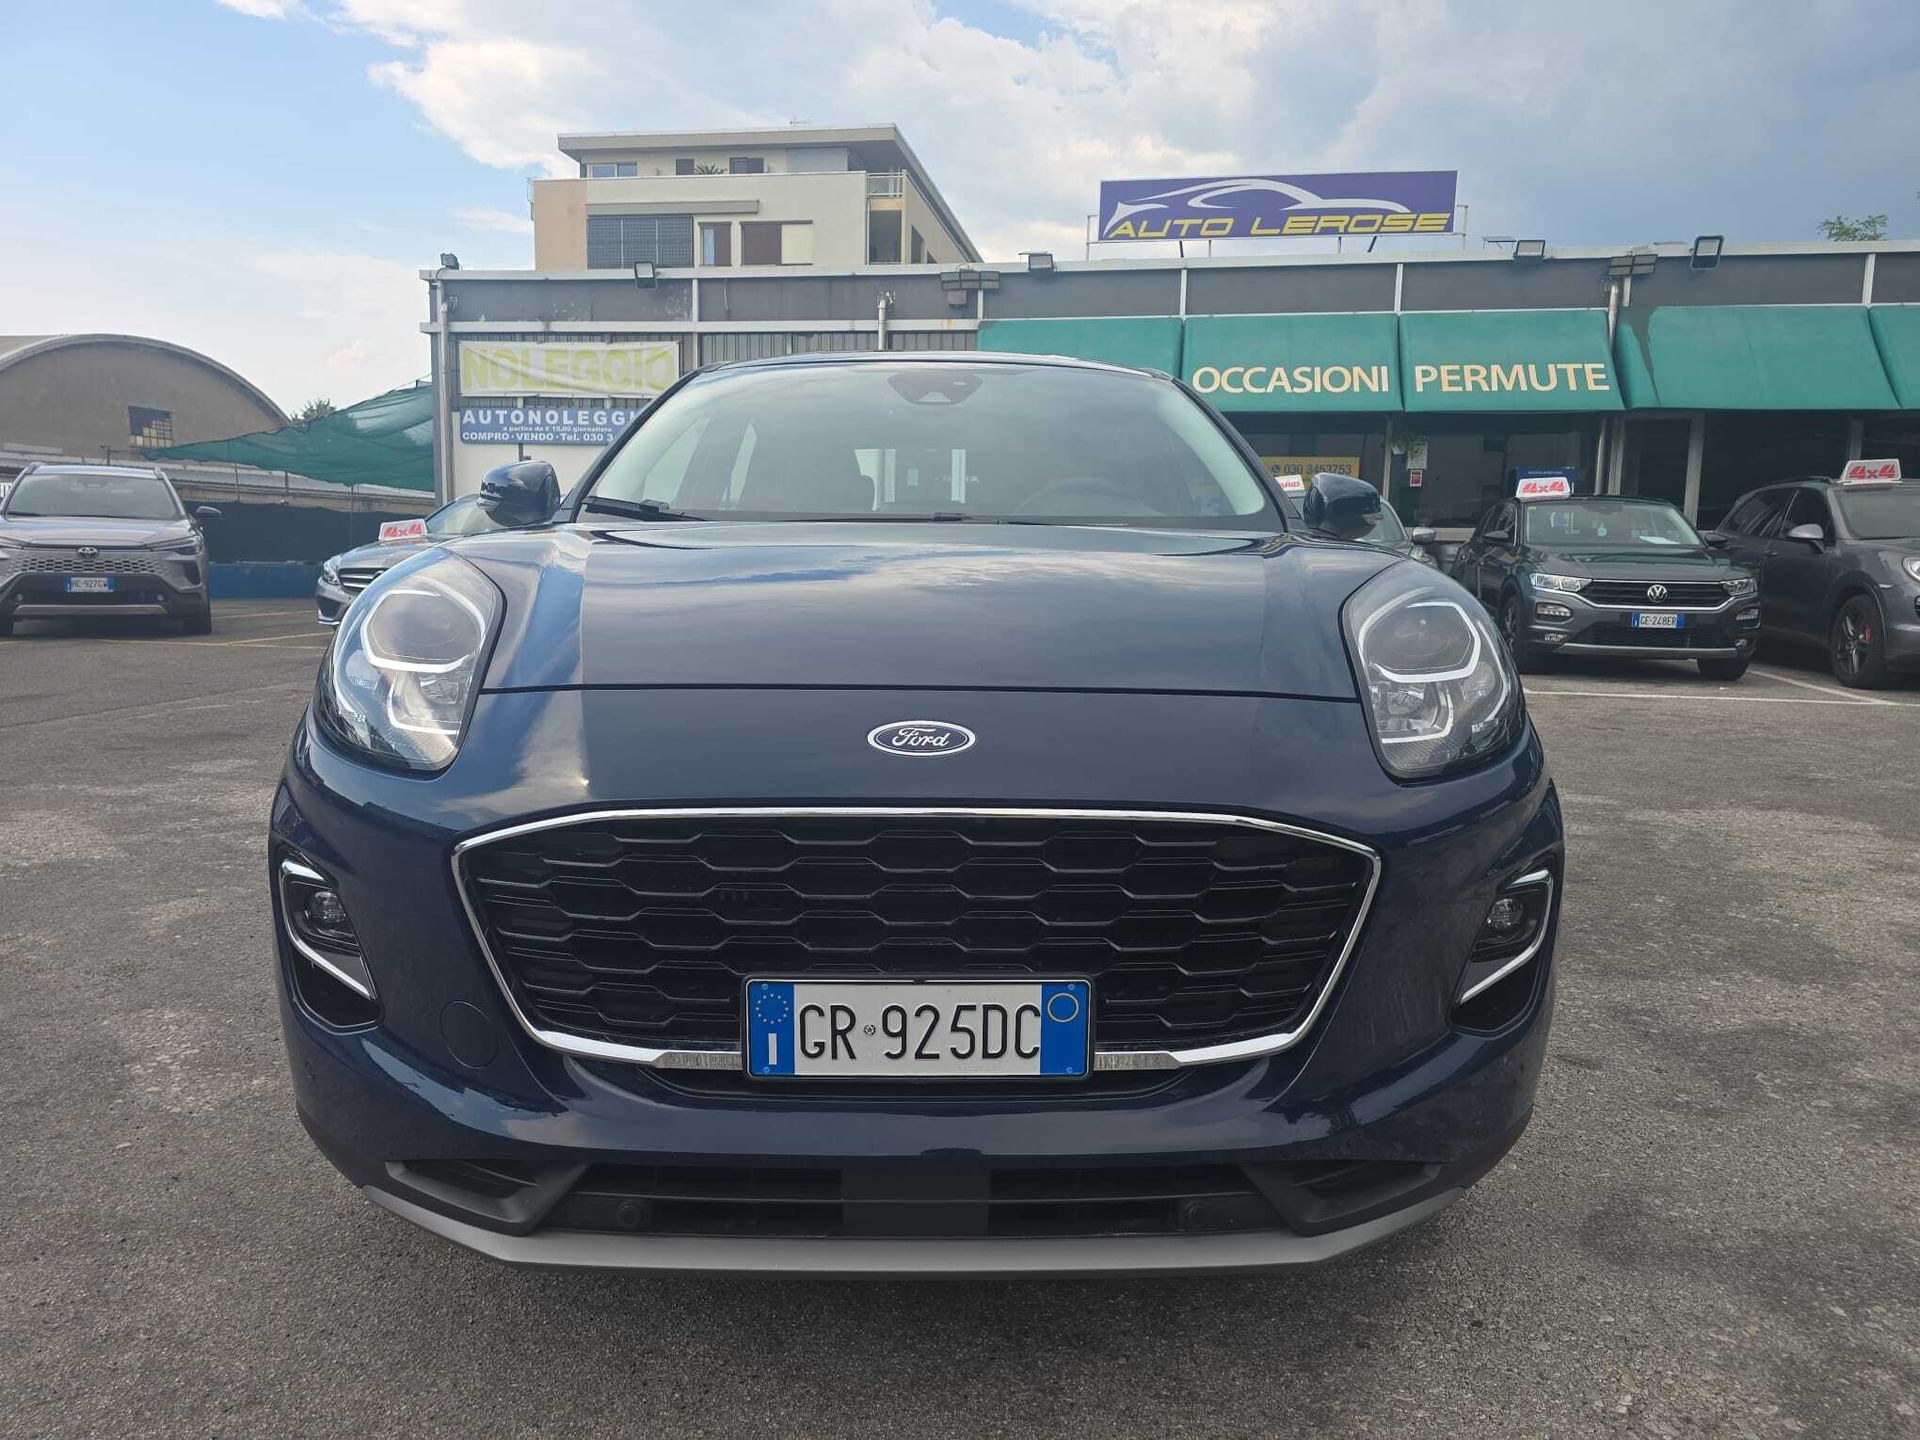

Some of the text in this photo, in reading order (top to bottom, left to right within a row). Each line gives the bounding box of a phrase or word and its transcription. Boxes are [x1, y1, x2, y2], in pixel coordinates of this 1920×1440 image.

[1107, 212, 1451, 238] AUTO LEROSE
[463, 347, 676, 391] NOLEGGIO
[1192, 363, 1610, 394] OCCASIONI PERMUTE
[462, 432, 510, 441] COMPRO
[516, 432, 554, 441] VENDO
[560, 432, 580, 441] Tel.
[583, 432, 604, 441] 030
[1283, 463, 1304, 474] 030
[891, 727, 951, 747] Ford
[799, 1003, 1042, 1060] GR 925DC
